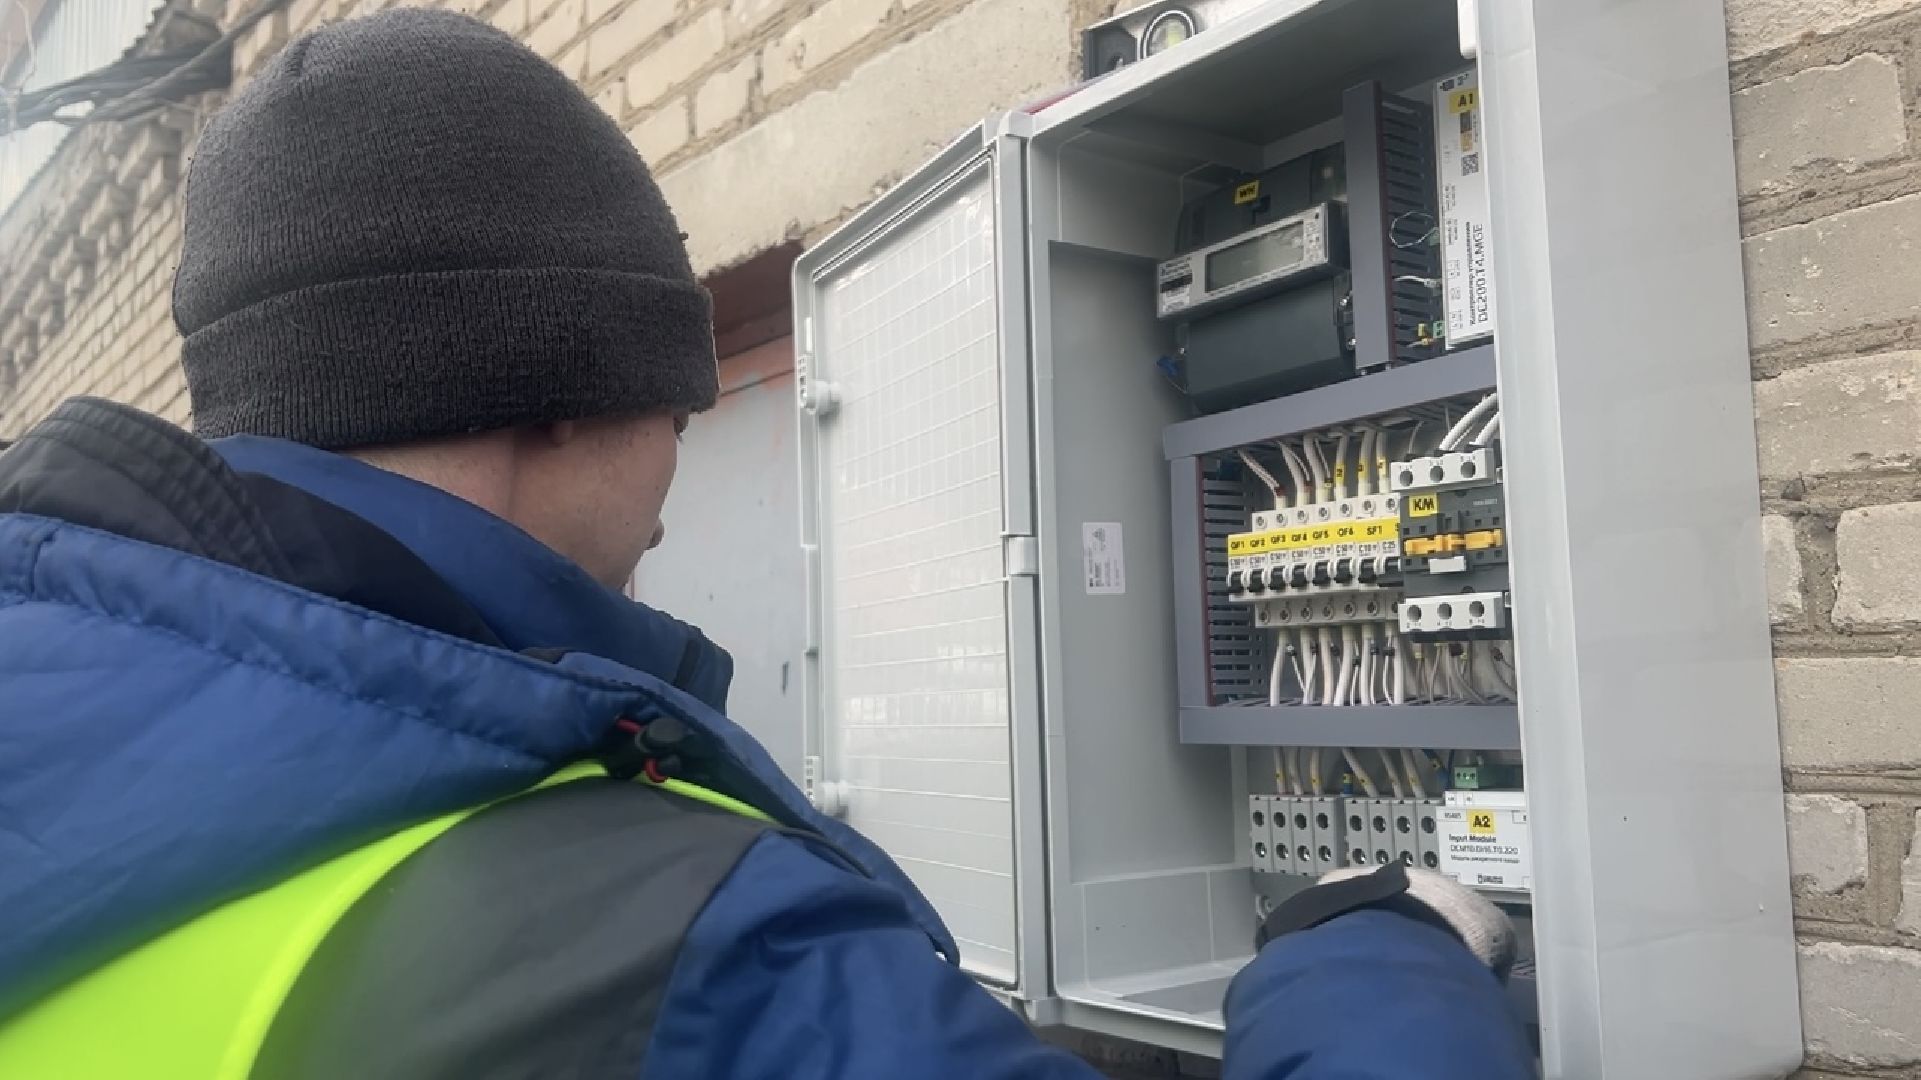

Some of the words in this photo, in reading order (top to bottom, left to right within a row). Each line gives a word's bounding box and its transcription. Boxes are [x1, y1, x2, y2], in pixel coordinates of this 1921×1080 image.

[1458, 93, 1473, 107] A1
[1413, 498, 1434, 511] KM
[1231, 541, 1244, 550] QF1
[1250, 538, 1265, 548] QF2
[1270, 534, 1286, 544] QF3
[1291, 533, 1307, 542] QF4
[1312, 530, 1329, 540] QF5
[1337, 526, 1353, 537] QF6
[1366, 525, 1382, 536] SF1
[1473, 815, 1490, 828] A2
[1449, 834, 1467, 842] Input
[1469, 835, 1496, 843] Module
